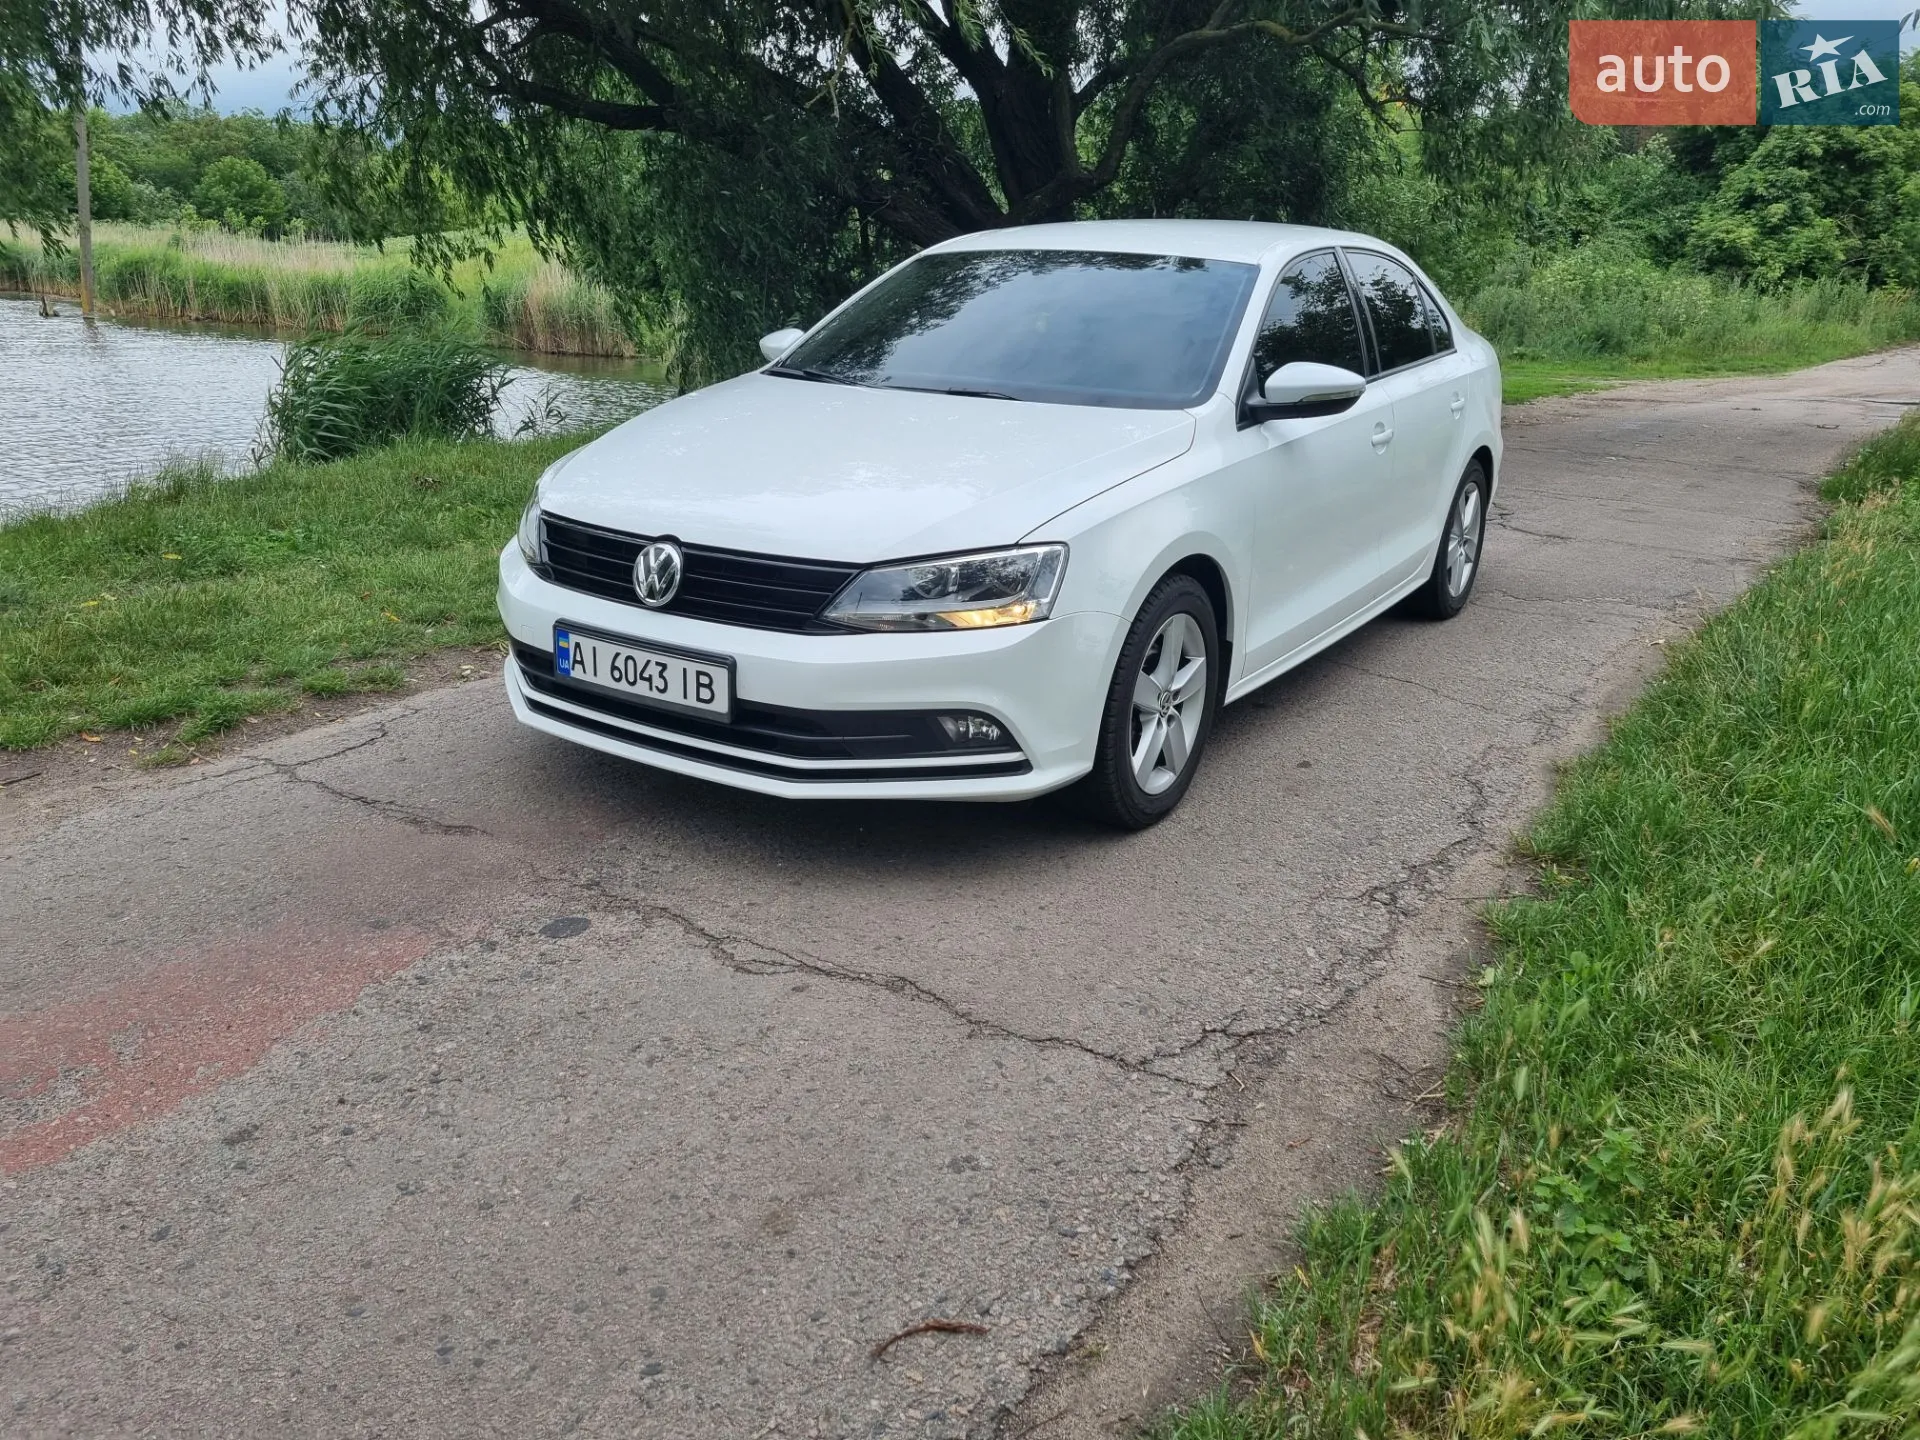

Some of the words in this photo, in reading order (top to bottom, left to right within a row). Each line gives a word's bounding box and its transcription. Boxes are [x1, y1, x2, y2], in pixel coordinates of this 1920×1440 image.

[559, 659, 570, 670] UA
[571, 641, 598, 678] AI
[610, 652, 668, 694] 6043
[683, 667, 715, 704] IB
